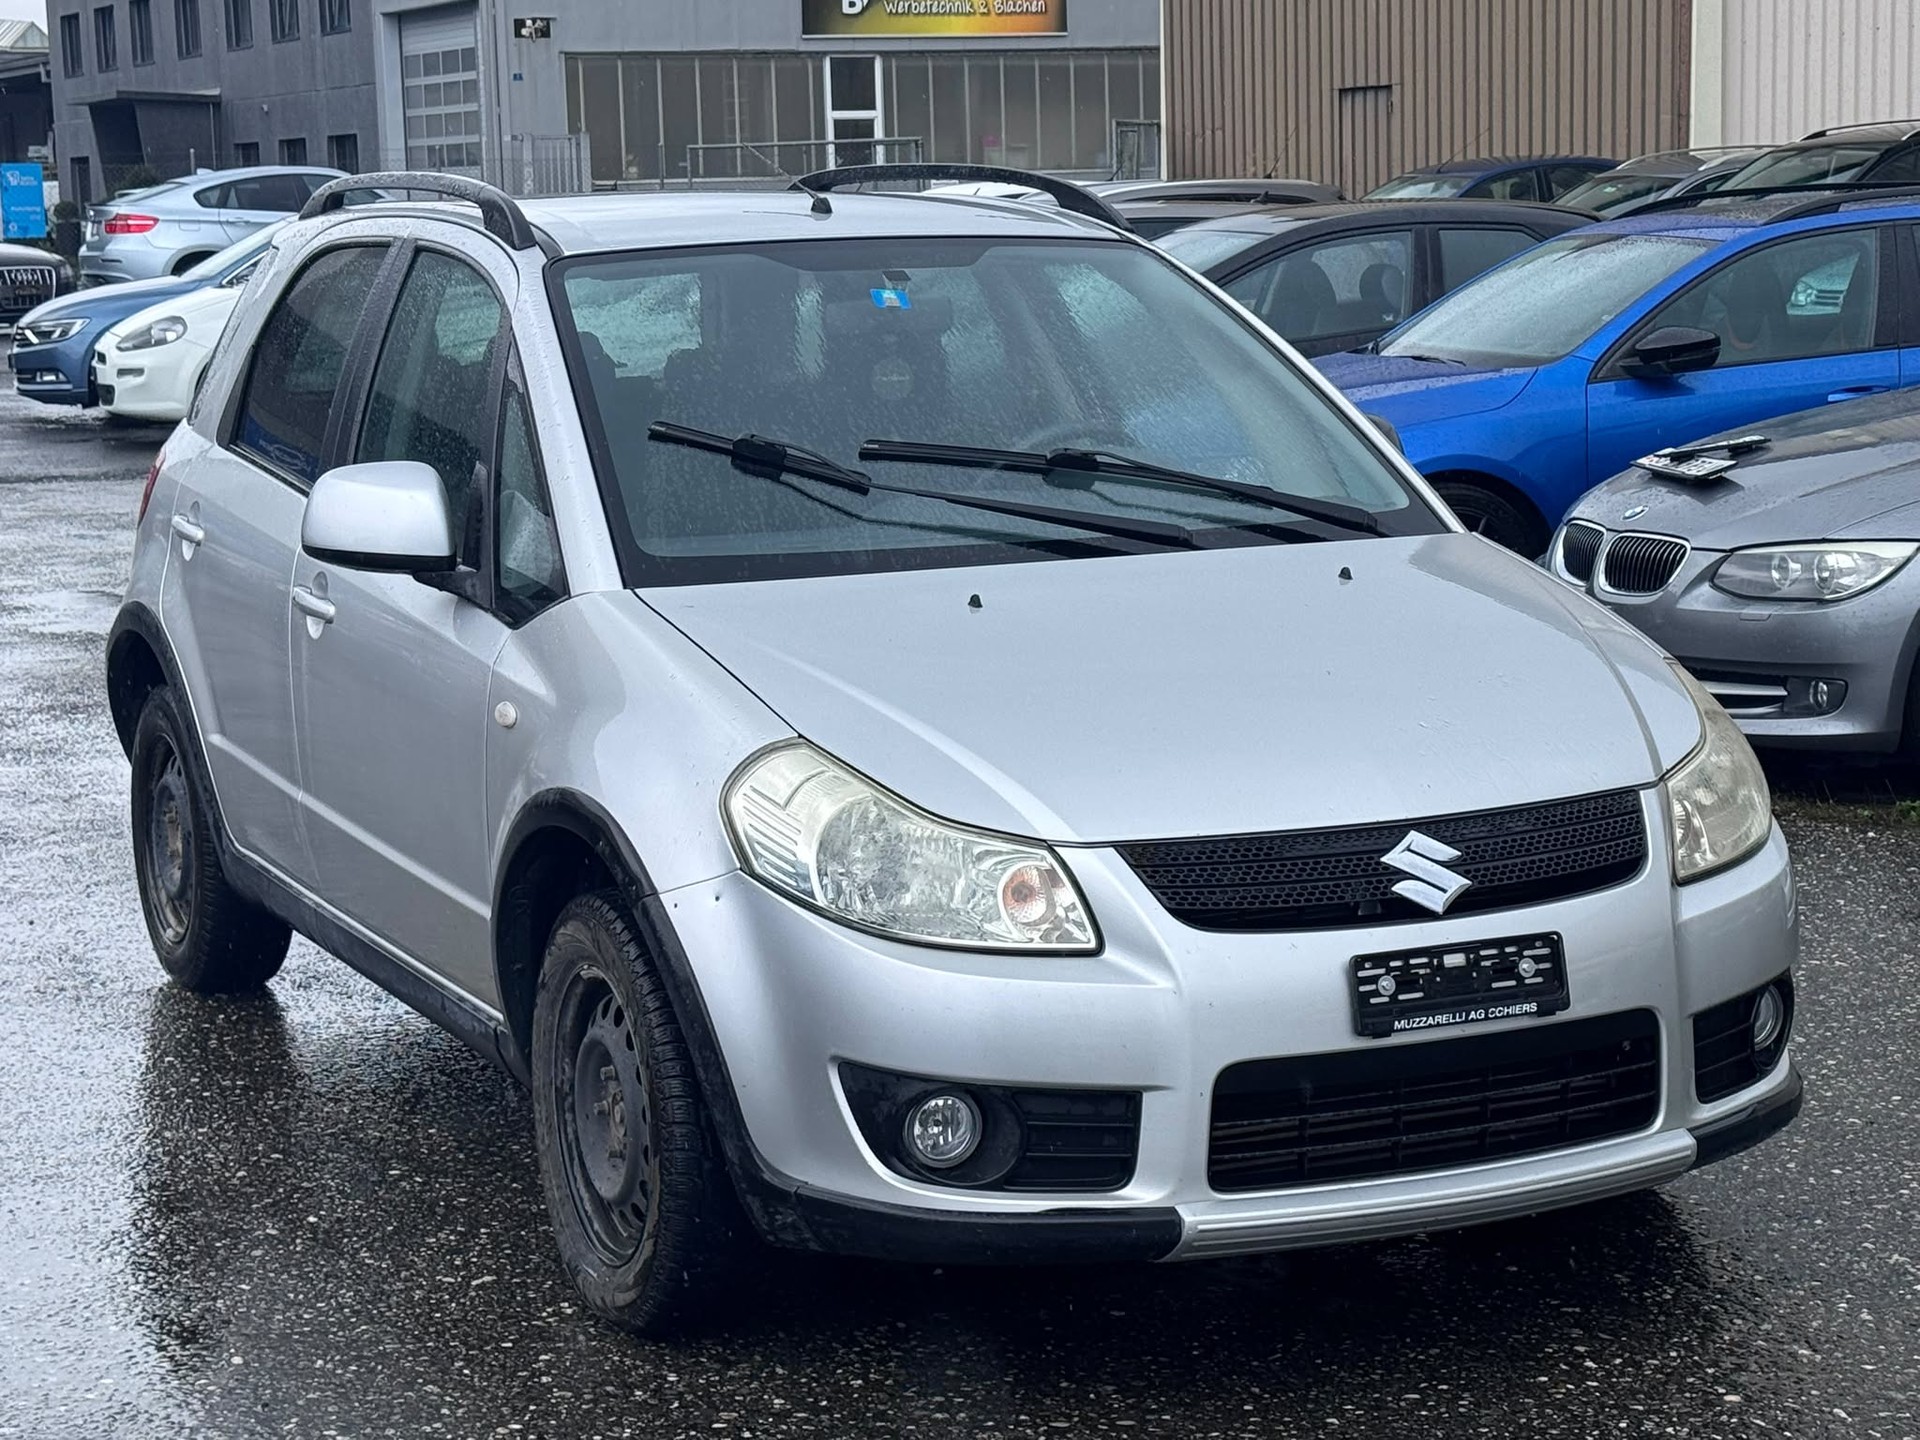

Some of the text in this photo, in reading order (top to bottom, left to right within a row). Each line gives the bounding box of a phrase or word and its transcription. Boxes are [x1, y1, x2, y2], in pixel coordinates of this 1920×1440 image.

[884, 0, 1046, 13] Werbetechnik & Blachen
[1393, 1011, 1466, 1030] MUZZARELLI
[1468, 1010, 1485, 1020] AG
